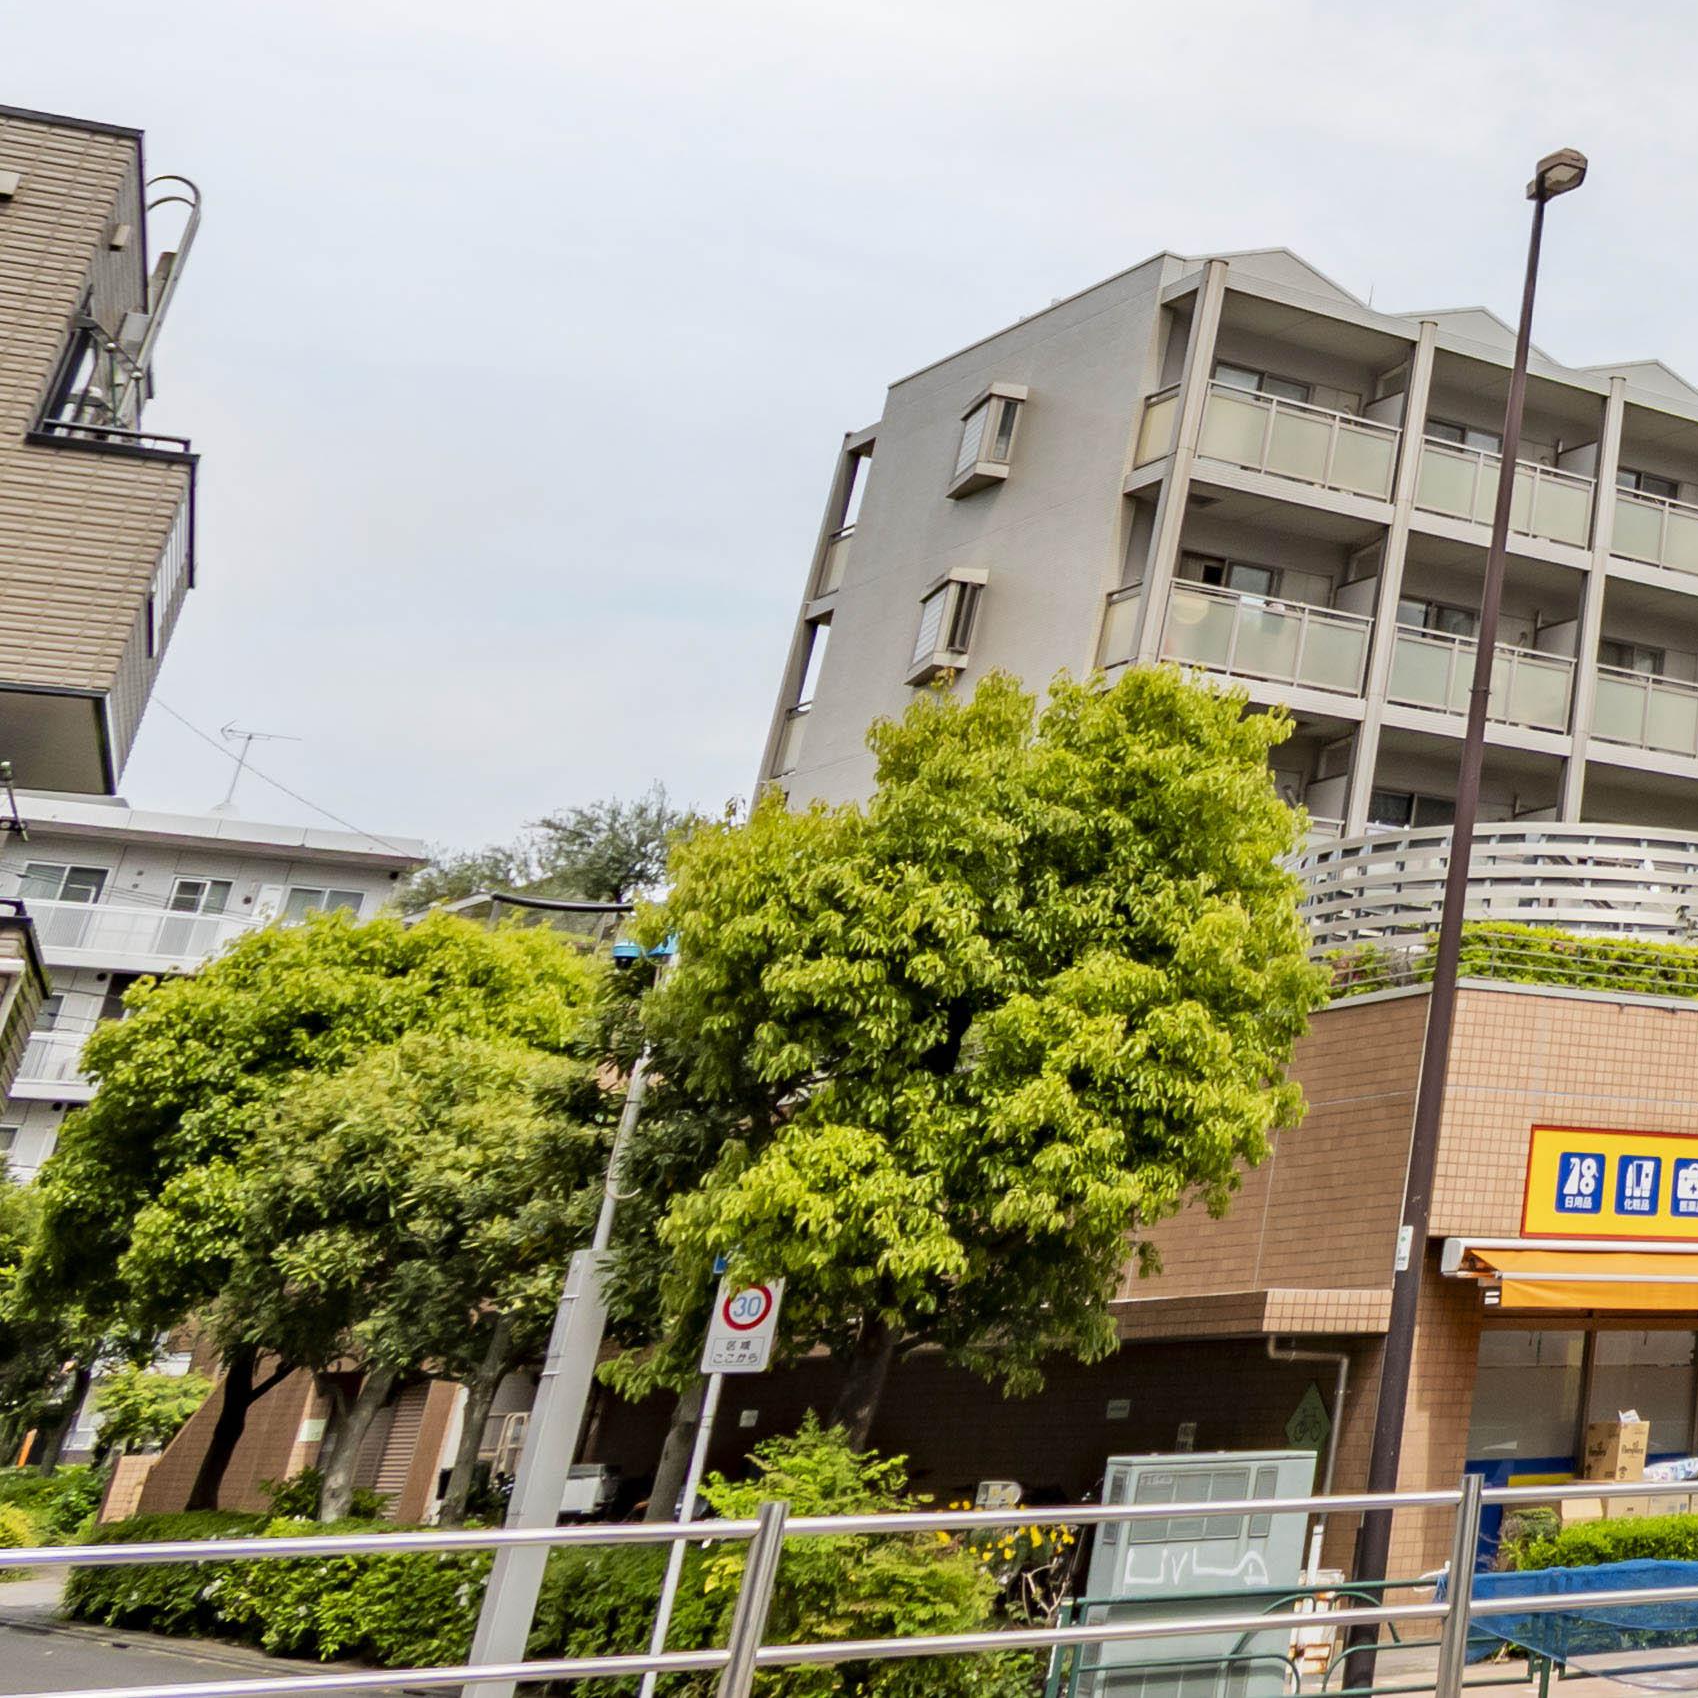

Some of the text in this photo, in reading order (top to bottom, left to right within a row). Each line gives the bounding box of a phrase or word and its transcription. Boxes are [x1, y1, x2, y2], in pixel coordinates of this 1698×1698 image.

[1564, 1196, 1593, 1210] 日用品
[733, 1296, 762, 1318] 30
[713, 1353, 759, 1364] ここから
